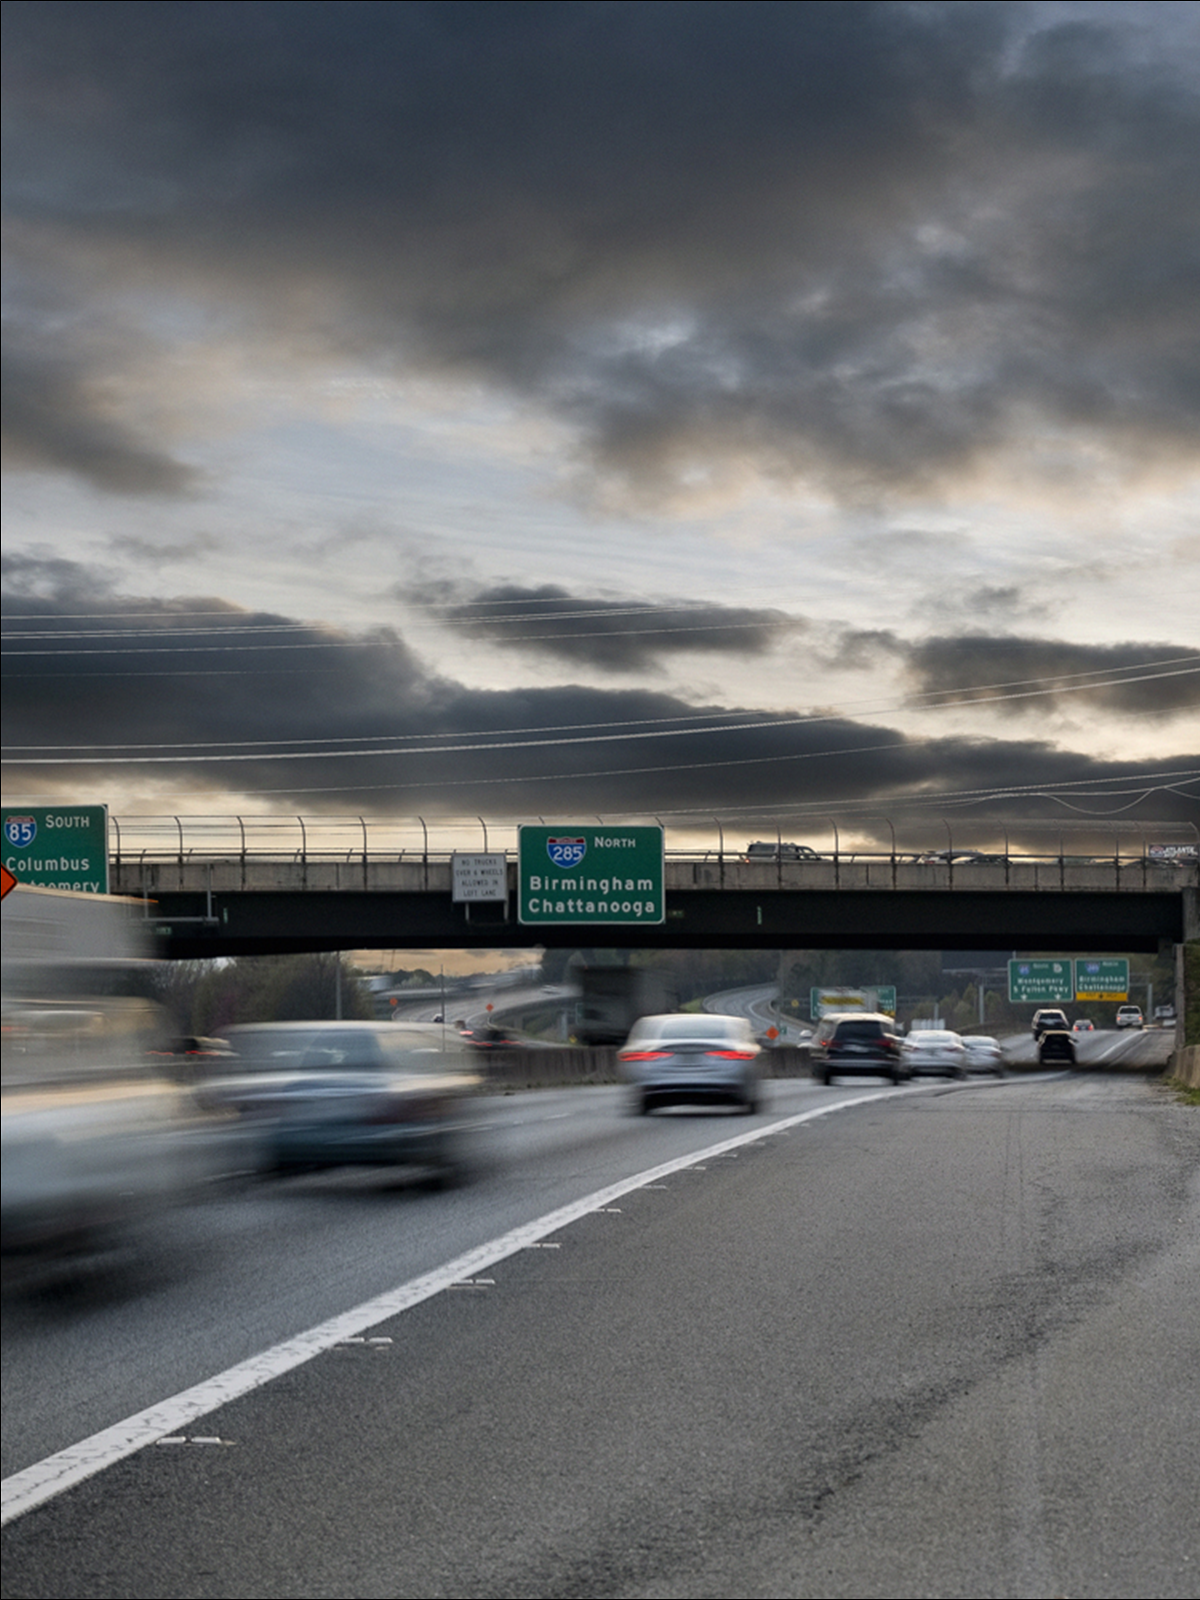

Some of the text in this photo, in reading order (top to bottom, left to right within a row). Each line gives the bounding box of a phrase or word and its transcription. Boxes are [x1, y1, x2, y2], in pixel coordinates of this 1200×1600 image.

[45, 814, 90, 829] SOUTH
[9, 823, 32, 841] 85
[594, 836, 636, 848] NORTH
[553, 845, 583, 861] 285
[6, 856, 91, 872] Columbus
[529, 876, 653, 895] Birmingham
[528, 898, 655, 917] Chattanooga
[1079, 975, 1125, 984] Birmingham
